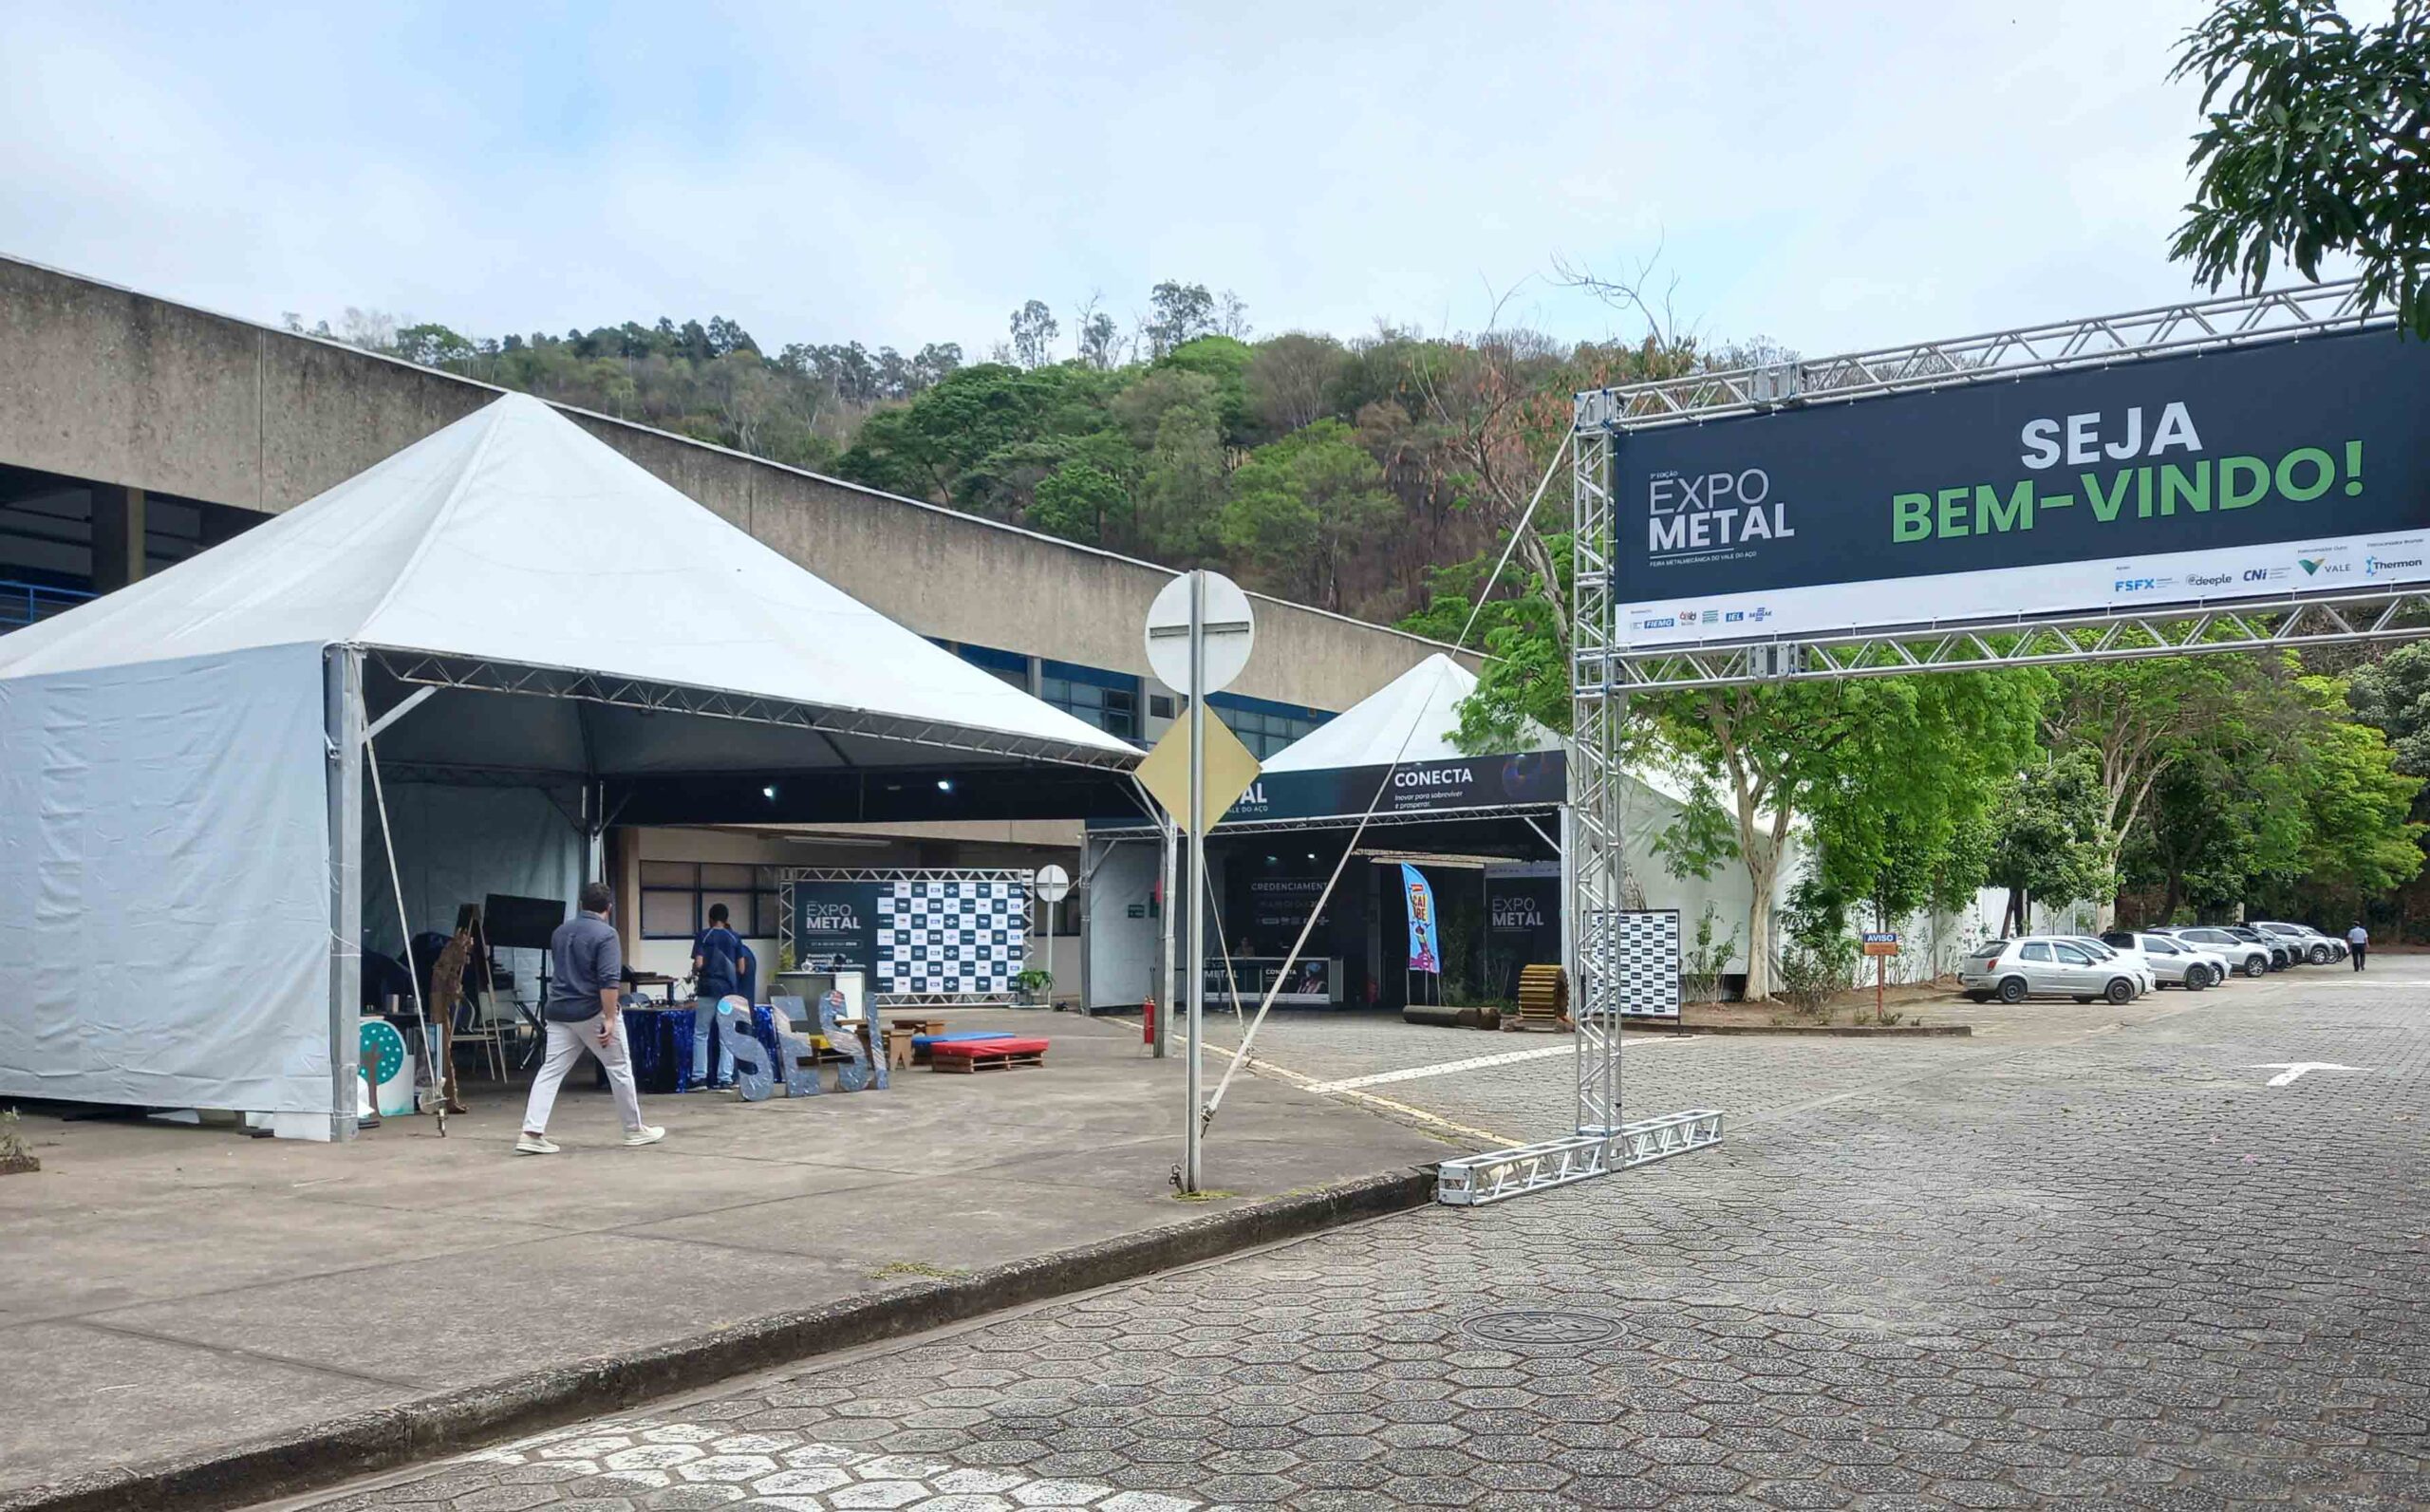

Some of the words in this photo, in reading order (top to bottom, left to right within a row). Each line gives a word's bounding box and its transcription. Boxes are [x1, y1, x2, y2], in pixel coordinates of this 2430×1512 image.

[2021, 401, 2203, 470] SEJA
[1650, 468, 1769, 515] EXPO
[1892, 440, 2364, 544] BEM-VINDO!
[1649, 502, 1795, 552] METAL
[1666, 555, 1710, 566] METALMECÂNICA
[2373, 558, 2422, 570] Thermon
[2325, 563, 2351, 573] VALE
[2115, 578, 2155, 592] FSFX
[1646, 619, 1673, 628] FIEMG
[1728, 612, 1742, 622] IEL
[1394, 767, 1473, 788] CONECTA
[1415, 793, 1430, 801] para
[1254, 805, 1269, 813] AÇO
[1251, 882, 1329, 891] CREDENCIAMENT
[806, 904, 852, 917] EXPO
[1492, 897, 1536, 912] EXPO
[806, 916, 862, 929] METAL
[1492, 911, 1544, 926] METAL
[1867, 934, 1894, 943] AVISO
[716, 989, 889, 1102] SESI
